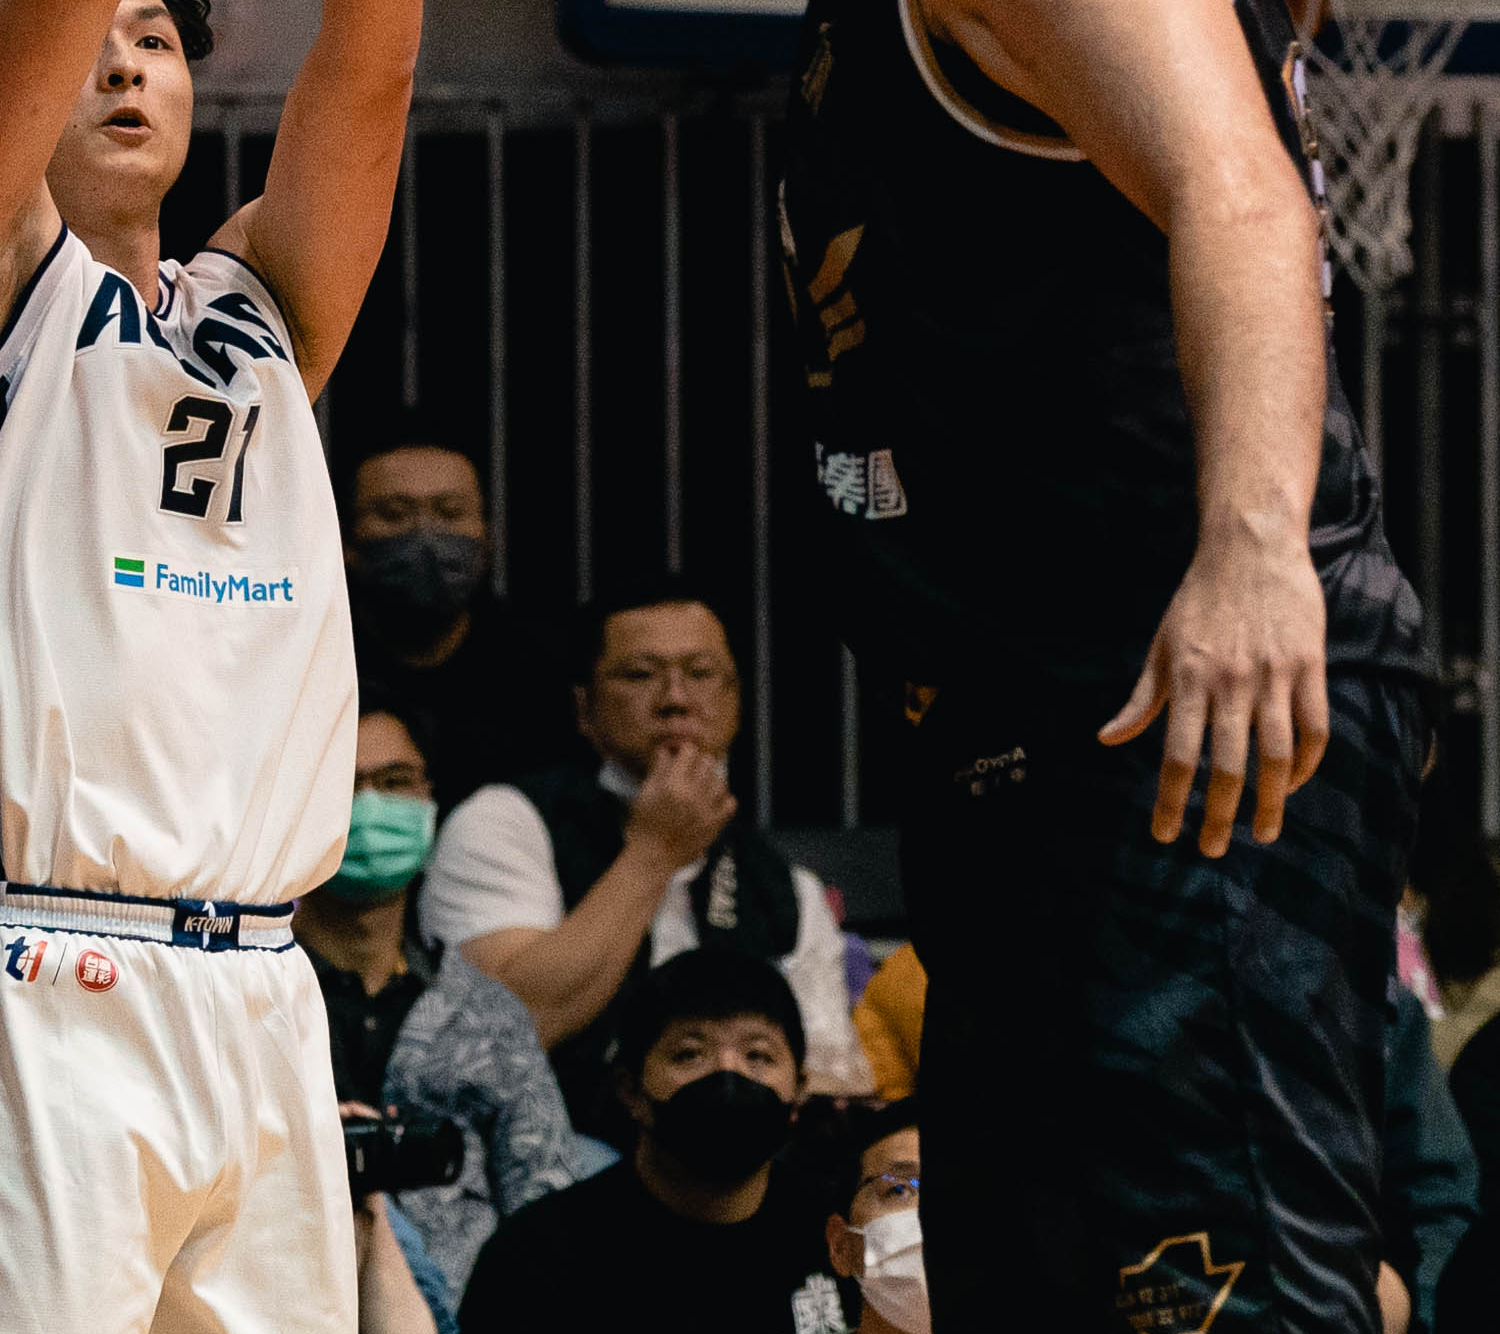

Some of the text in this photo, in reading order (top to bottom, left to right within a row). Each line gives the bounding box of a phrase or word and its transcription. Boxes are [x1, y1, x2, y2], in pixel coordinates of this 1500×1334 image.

[158, 394, 261, 524] 21
[156, 562, 293, 603] FamilyMart
[184, 915, 233, 934] K-TOWN
